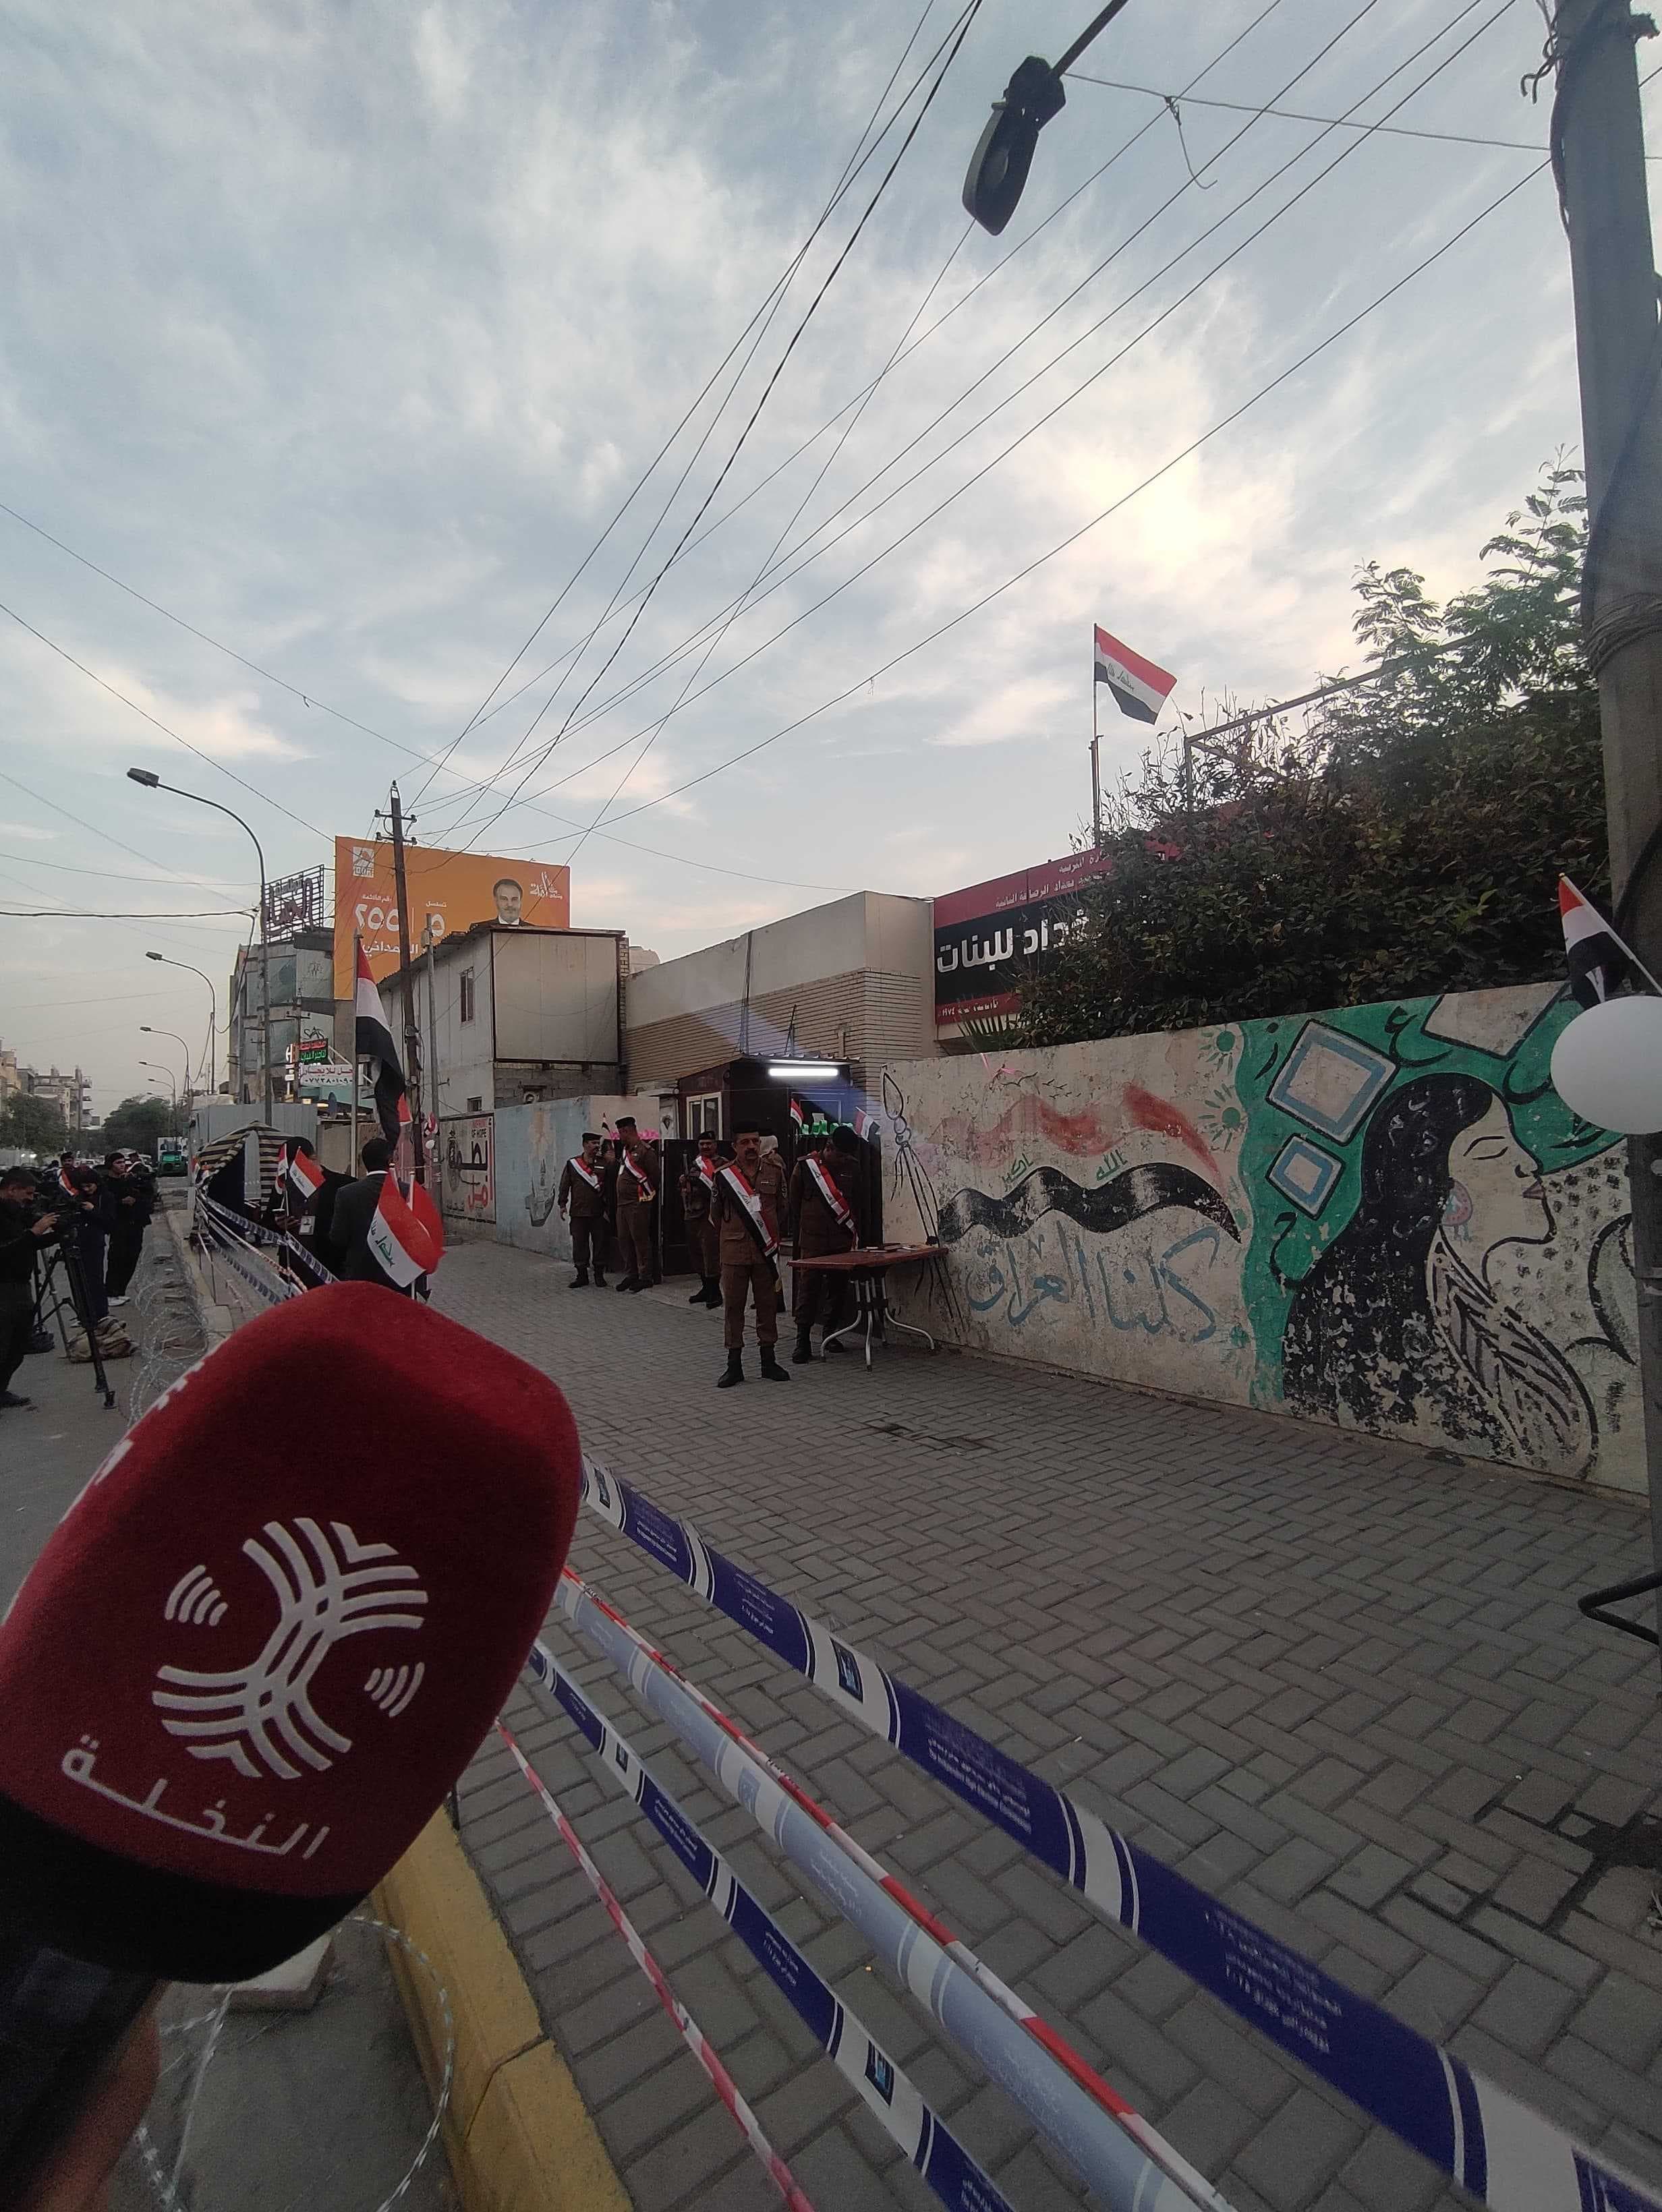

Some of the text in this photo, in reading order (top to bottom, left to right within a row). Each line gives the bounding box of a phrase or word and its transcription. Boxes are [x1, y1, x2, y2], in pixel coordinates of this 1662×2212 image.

[937, 928, 1013, 972] للبنات
[1096, 1147, 1128, 1182] الله
[965, 1221, 1221, 1345] كلنا العراق
[60, 1734, 331, 1861] النخلة
